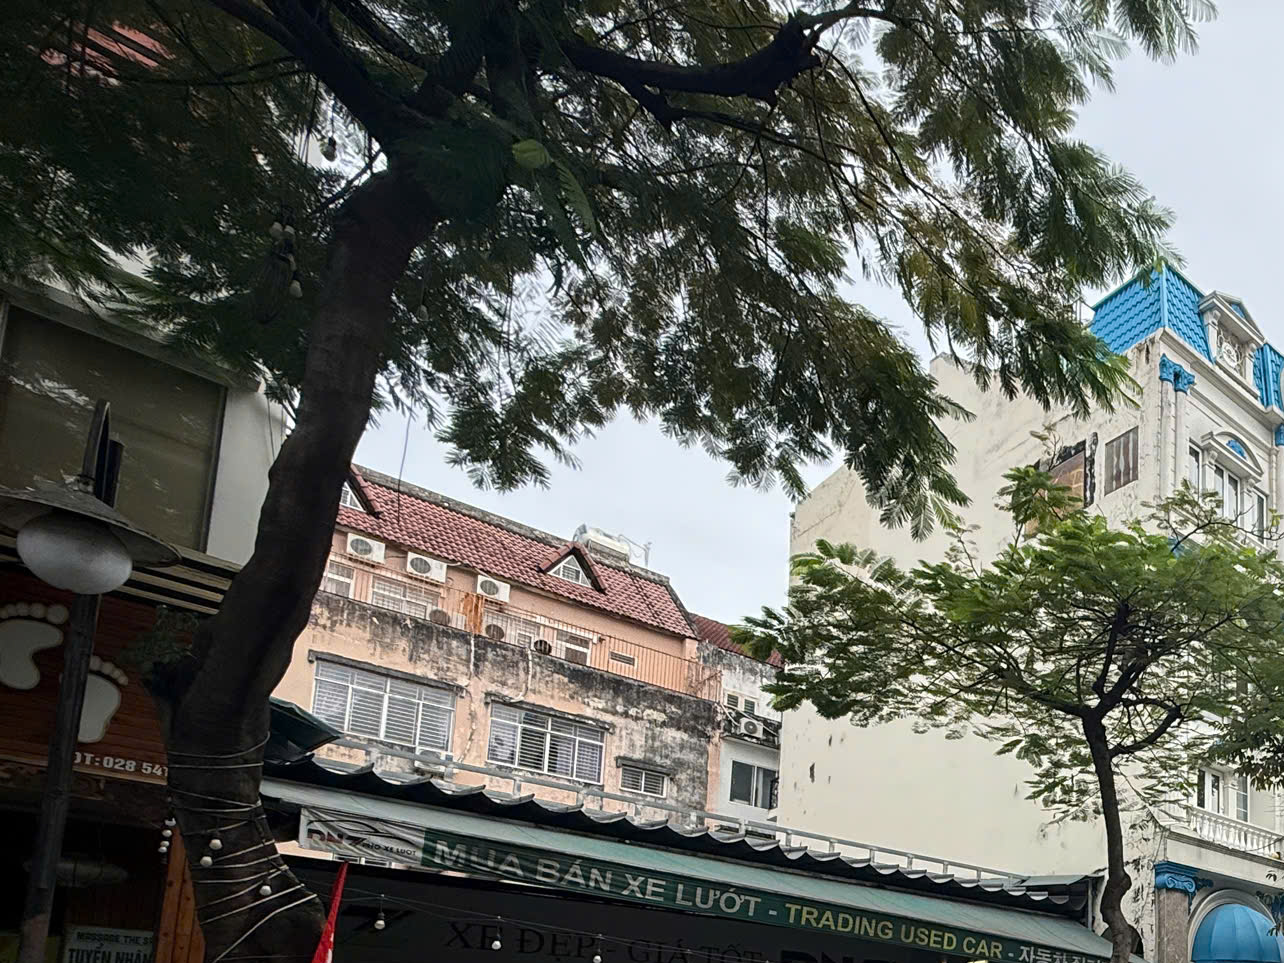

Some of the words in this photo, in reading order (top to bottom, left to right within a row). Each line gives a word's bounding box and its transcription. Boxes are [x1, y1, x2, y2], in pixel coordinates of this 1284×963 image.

[102, 756, 136, 772] 028
[434, 840, 524, 877] MUA
[535, 858, 612, 892] BÁN
[620, 873, 667, 902] XE
[675, 883, 762, 917] LƯỚT
[785, 904, 893, 940] TRADING
[900, 924, 957, 951] USED
[962, 937, 1003, 958] CAR
